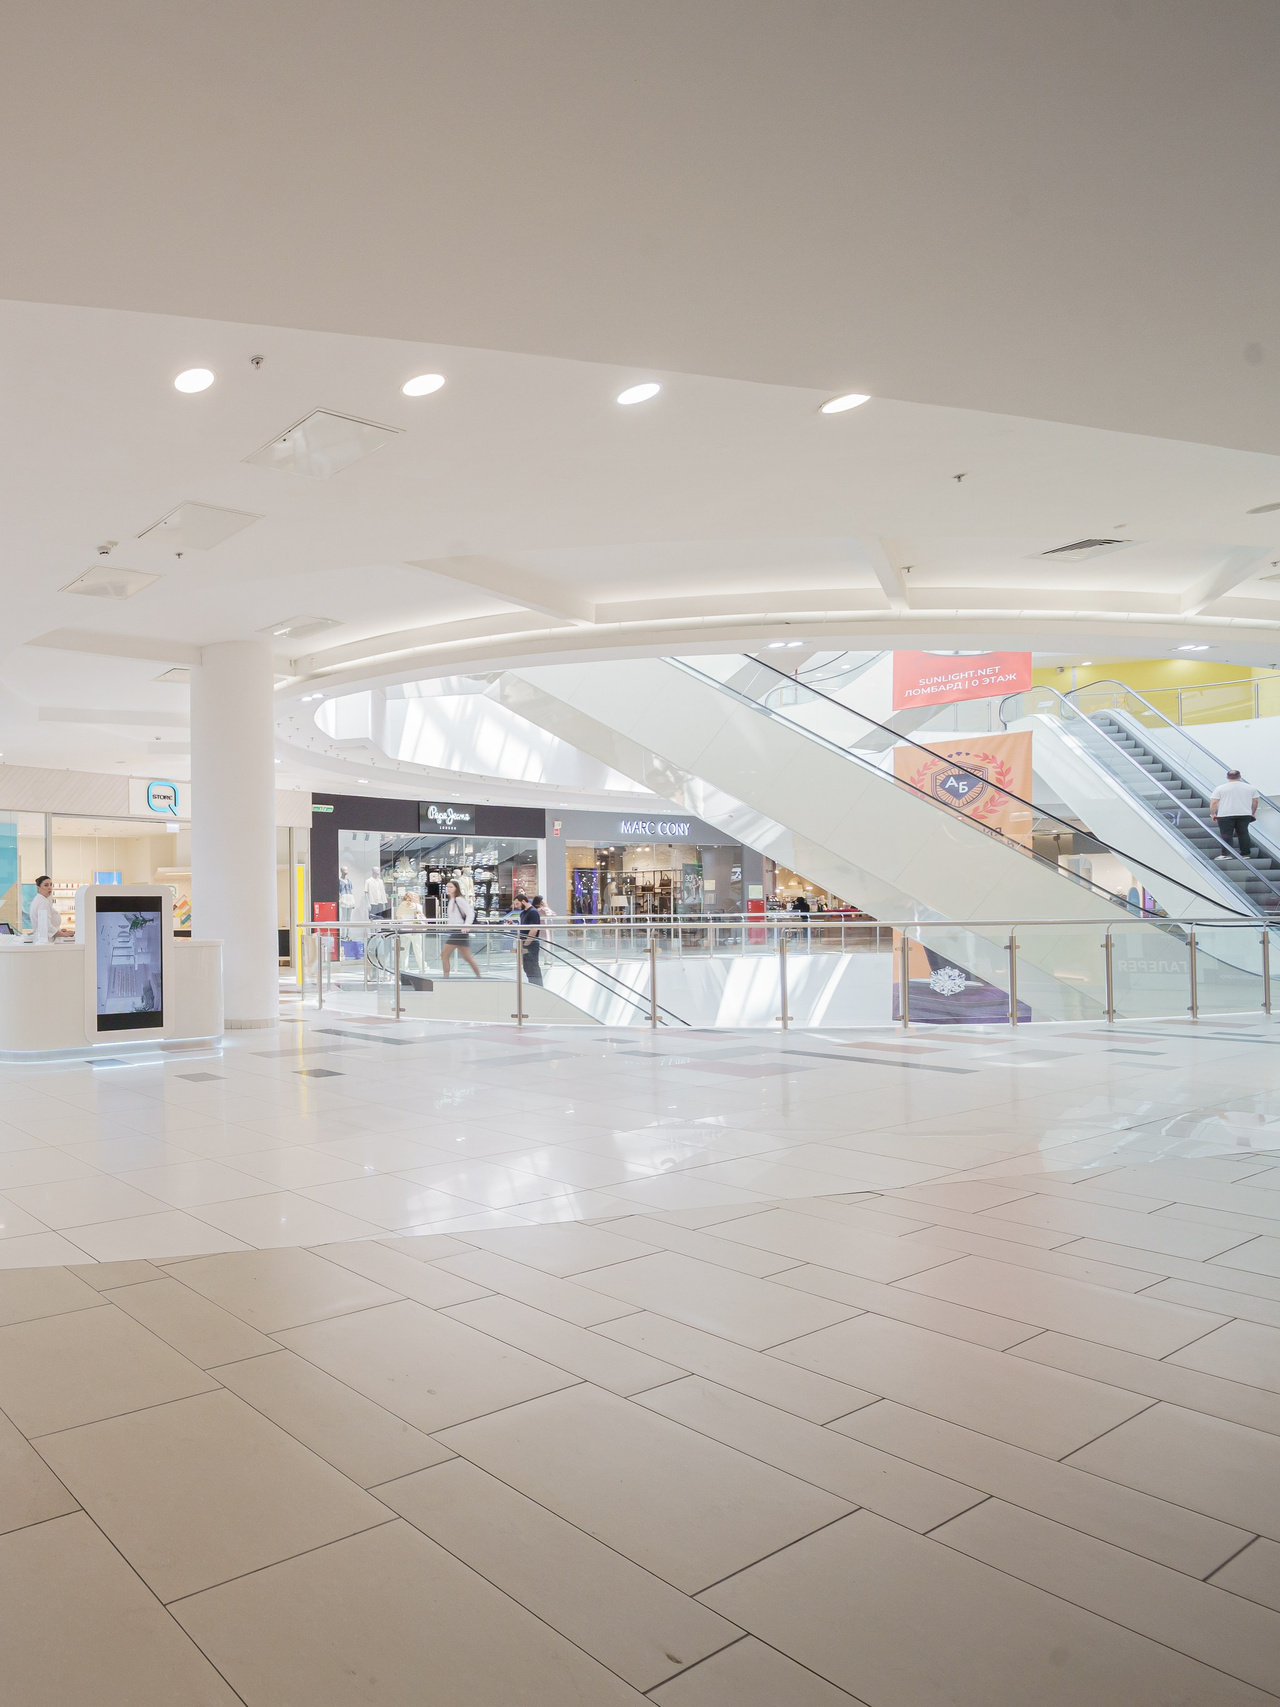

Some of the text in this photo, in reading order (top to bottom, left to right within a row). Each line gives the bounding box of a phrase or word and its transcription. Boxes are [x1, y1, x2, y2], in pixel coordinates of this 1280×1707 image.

[904, 682, 962, 697] ЛОМБАРД
[982, 673, 1017, 685] ЭТАЖ
[919, 666, 1001, 686] SUNLIGHT.NET
[945, 776, 969, 793] АБ
[427, 805, 449, 824] Pepe
[621, 821, 690, 836] MARC CONY
